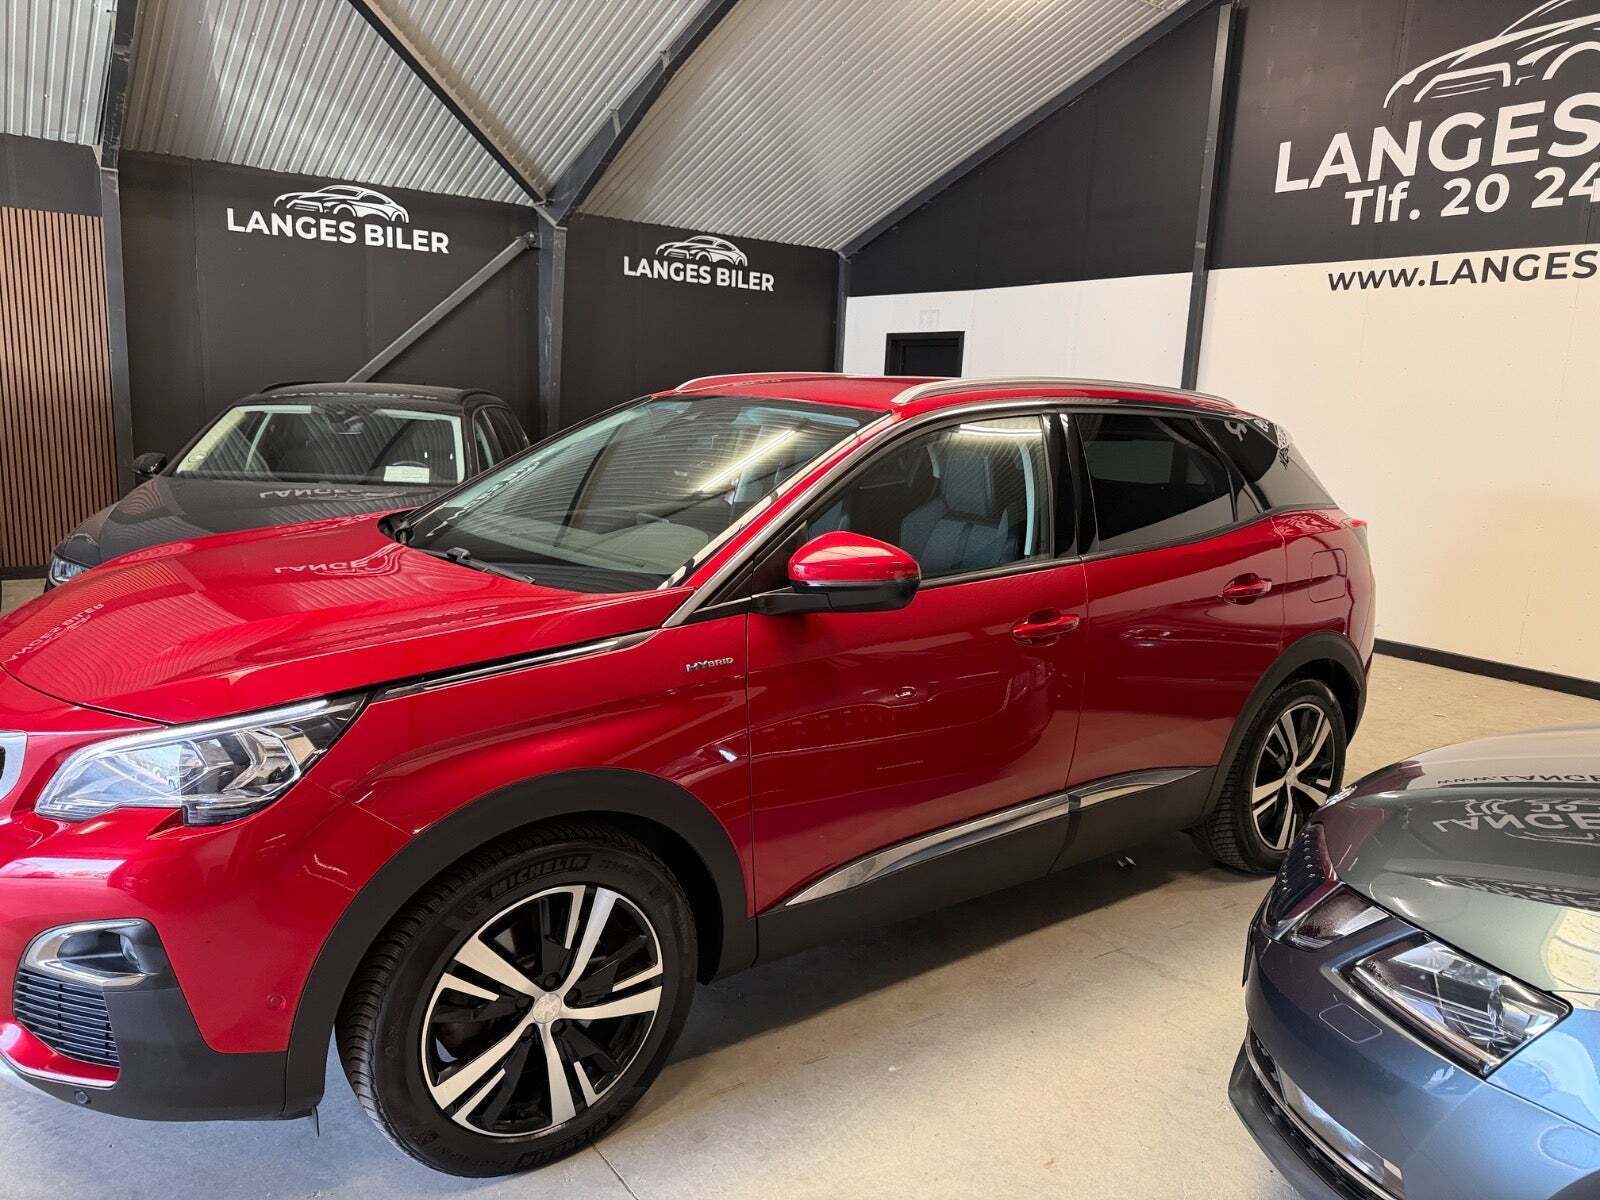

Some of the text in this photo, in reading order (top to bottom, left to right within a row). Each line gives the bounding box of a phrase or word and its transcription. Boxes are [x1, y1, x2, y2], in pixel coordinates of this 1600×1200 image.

[1275, 91, 1600, 193] LANGES
[1344, 162, 1600, 226] Tlf. 20 24
[226, 207, 449, 254] LANGES BILER
[623, 255, 775, 292] LANGES BILER
[1328, 250, 1599, 292] www.LANGES
[685, 656, 735, 673] HYBRID
[489, 854, 592, 901] MICHELIN
